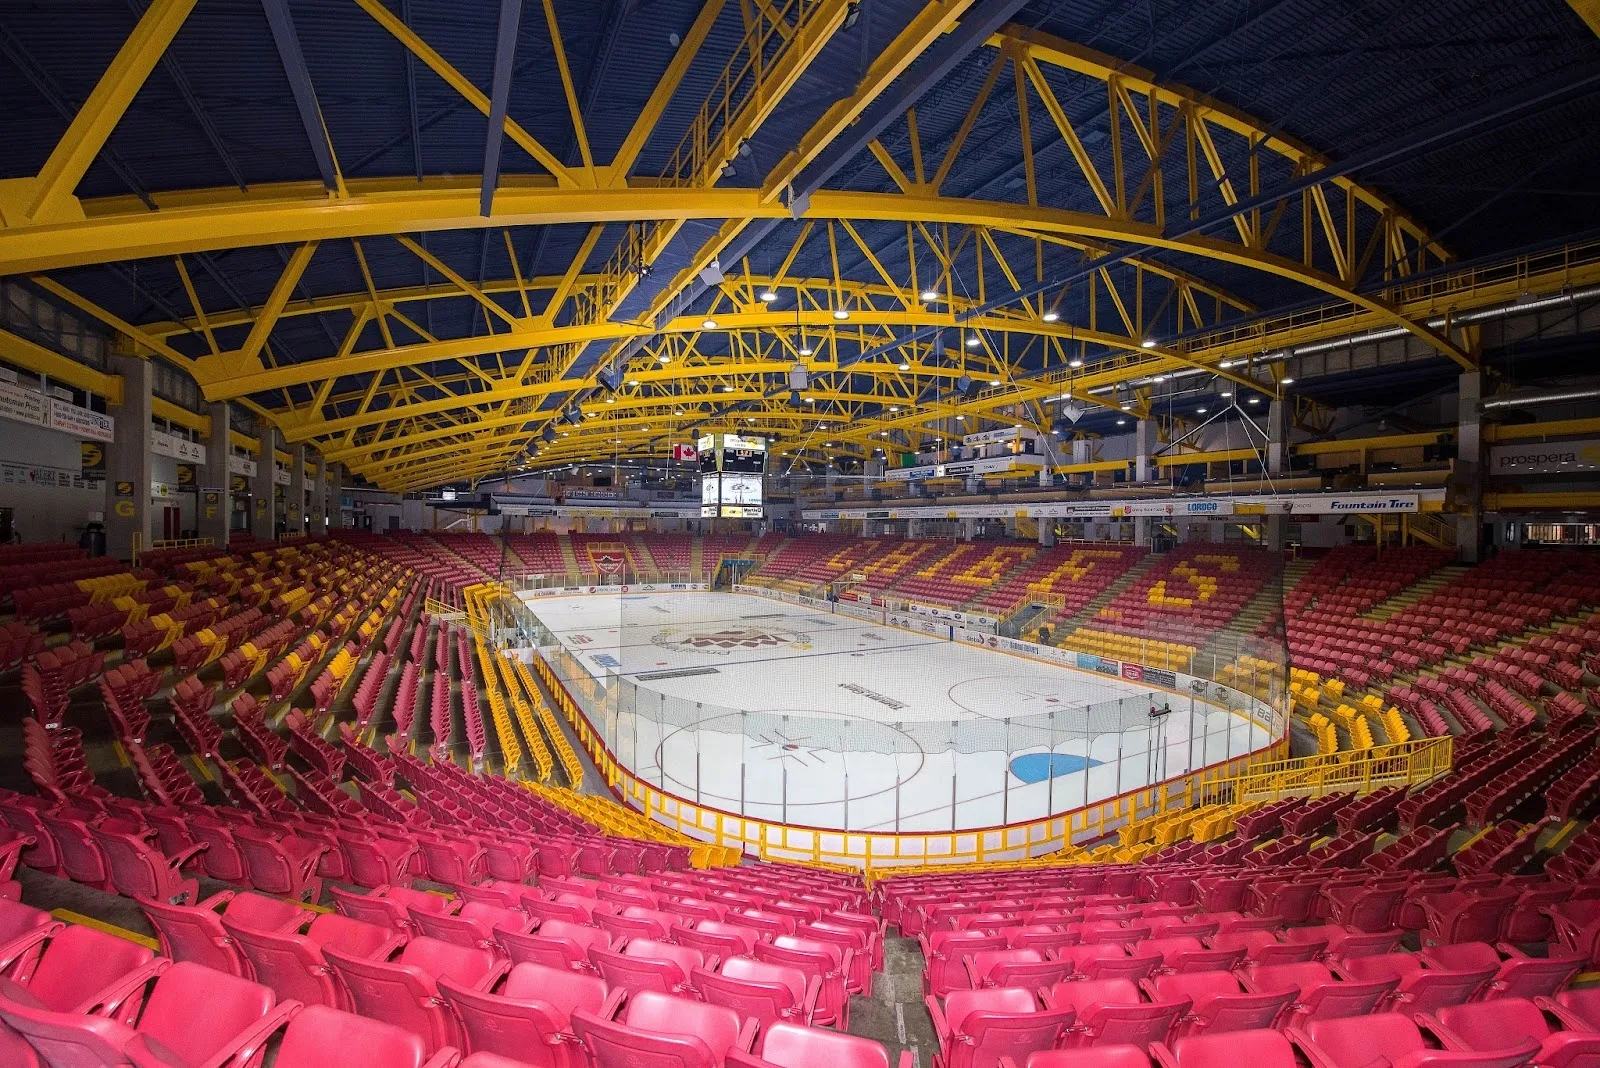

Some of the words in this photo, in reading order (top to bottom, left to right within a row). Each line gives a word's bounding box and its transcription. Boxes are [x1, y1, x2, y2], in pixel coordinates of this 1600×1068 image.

[1500, 452, 1577, 468] prospera
[115, 499, 136, 519] G
[1187, 502, 1218, 512] LORDCO
[1331, 500, 1387, 510] Fountain
[1389, 499, 1415, 509] Tire
